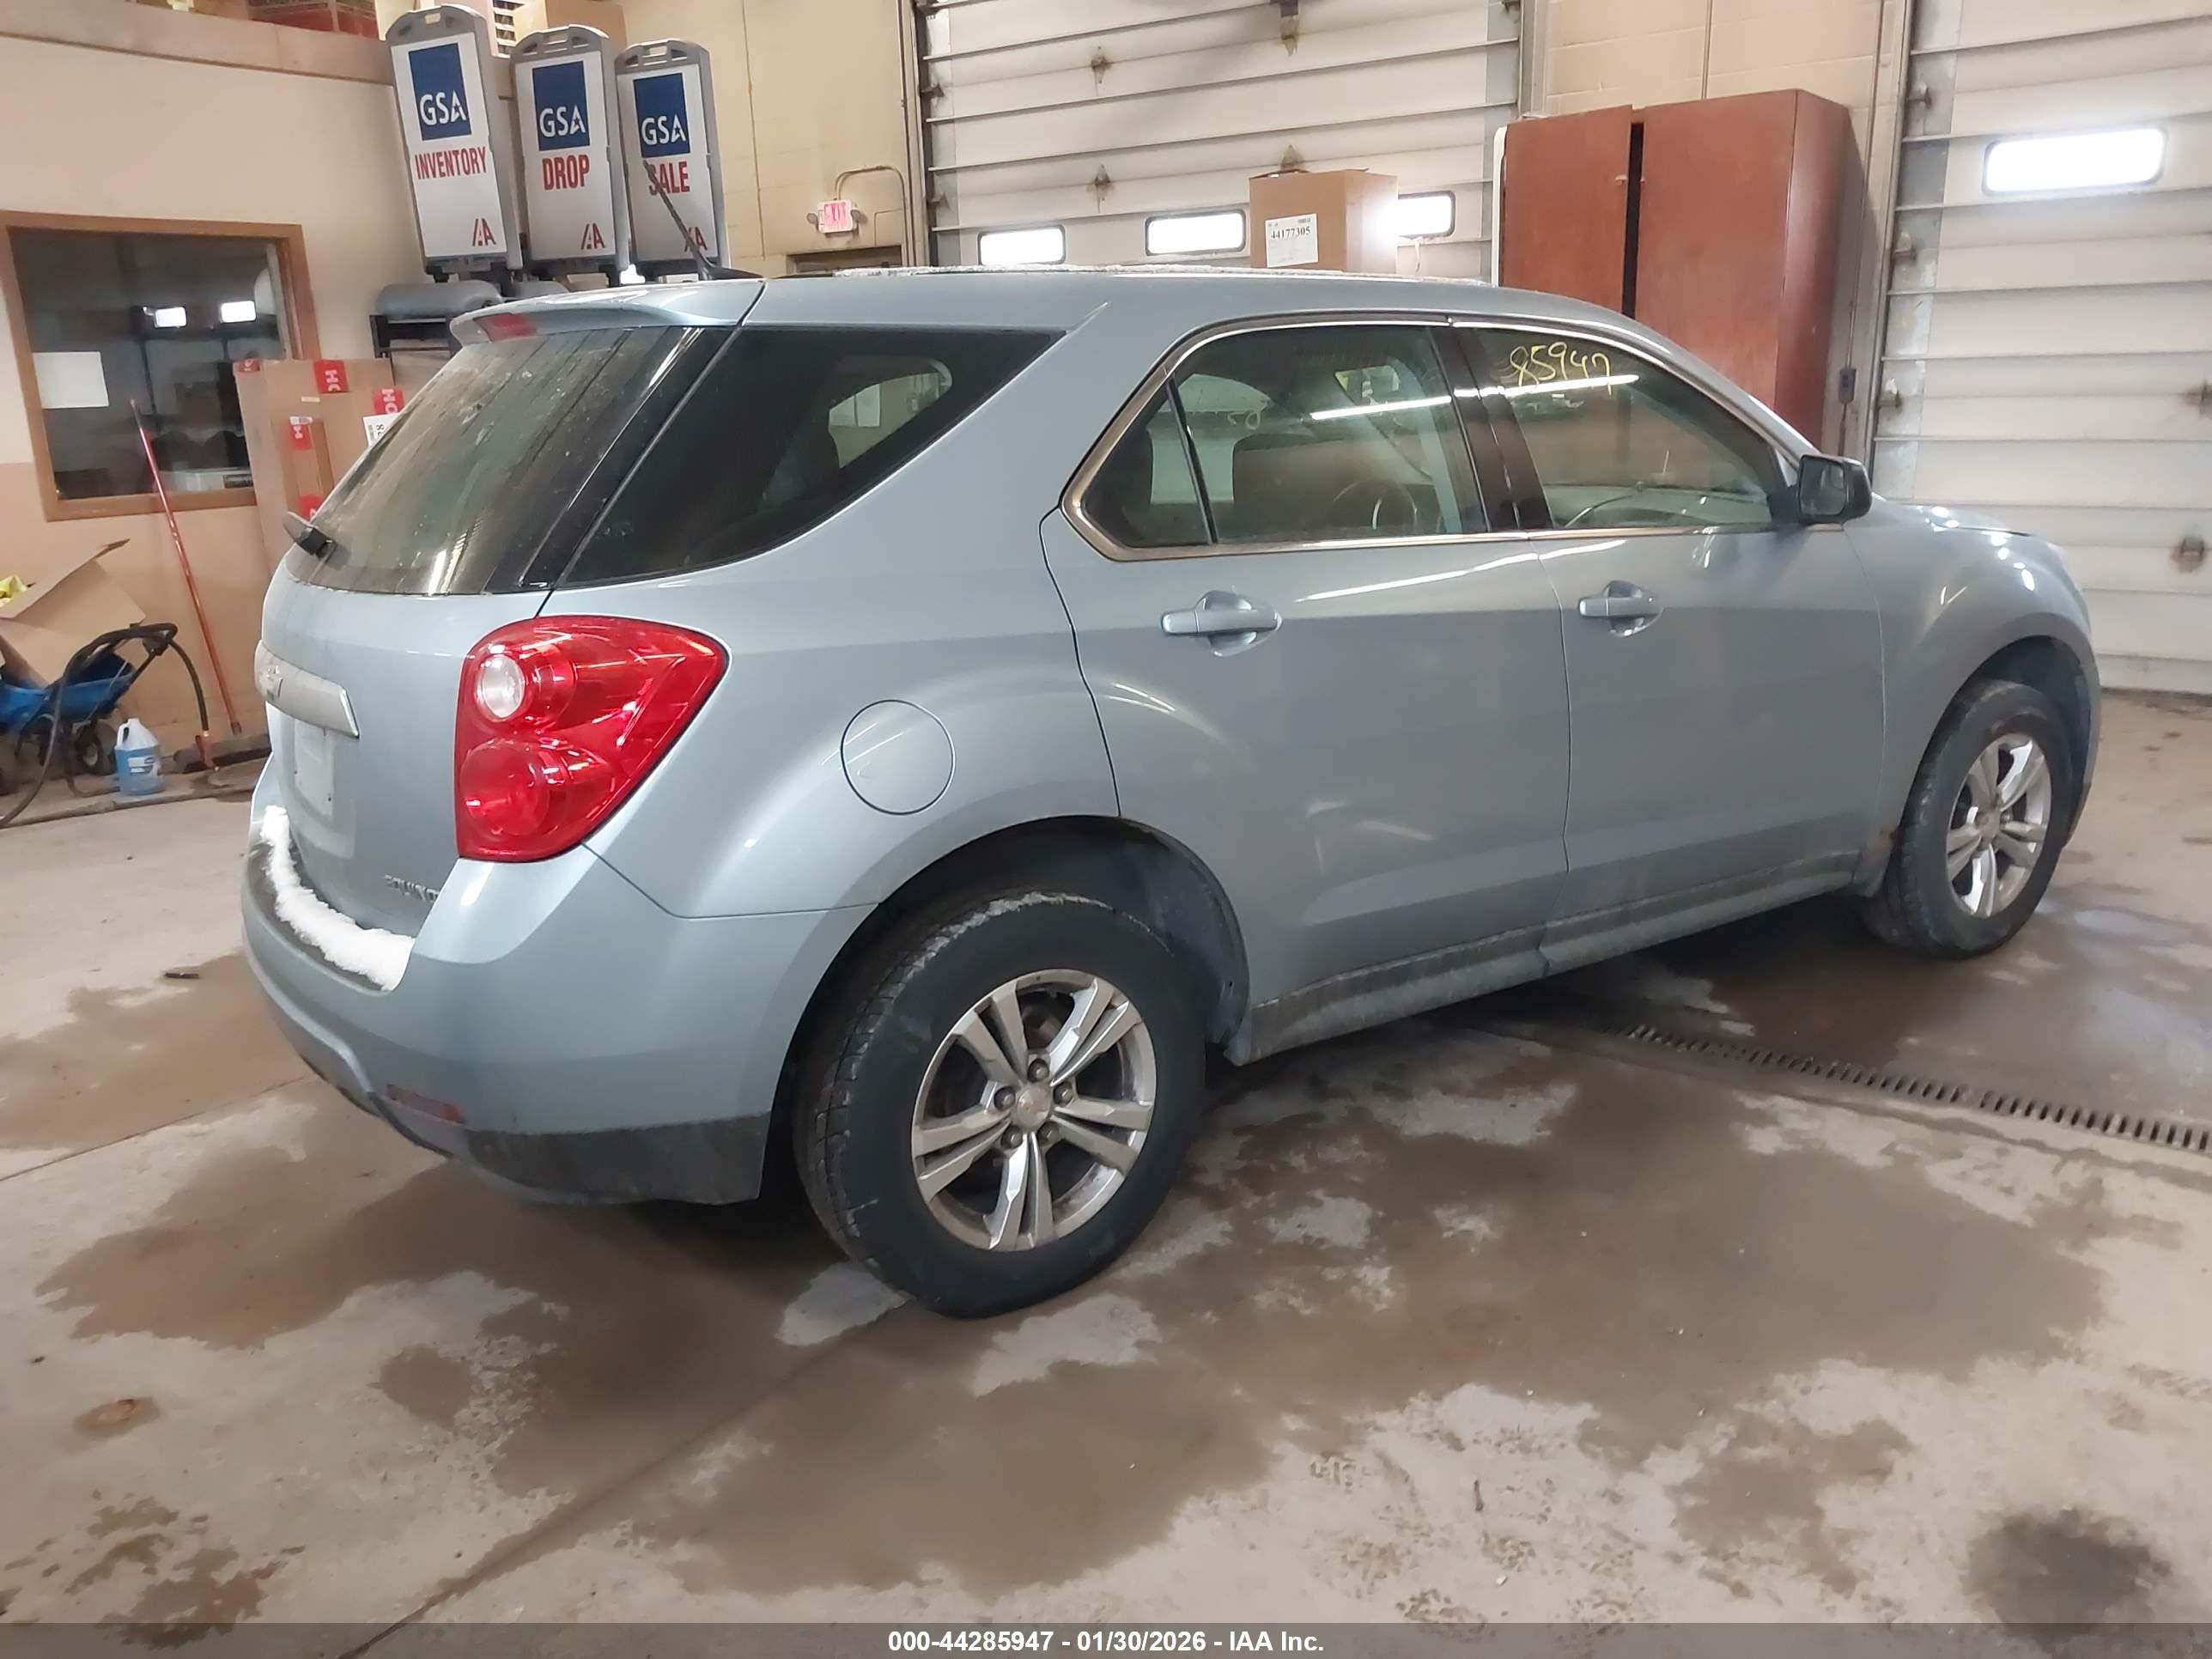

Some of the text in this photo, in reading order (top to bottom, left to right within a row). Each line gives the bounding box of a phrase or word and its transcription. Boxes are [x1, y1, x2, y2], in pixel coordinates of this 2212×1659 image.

[420, 90, 466, 125] GSA
[539, 105, 586, 137] GSA
[641, 113, 686, 145] GSA
[415, 146, 488, 179] INVENTORY
[542, 154, 590, 191] DROP
[649, 161, 690, 196] SALE
[1271, 226, 1311, 239] 44177305
[1510, 342, 1613, 397] 85947
